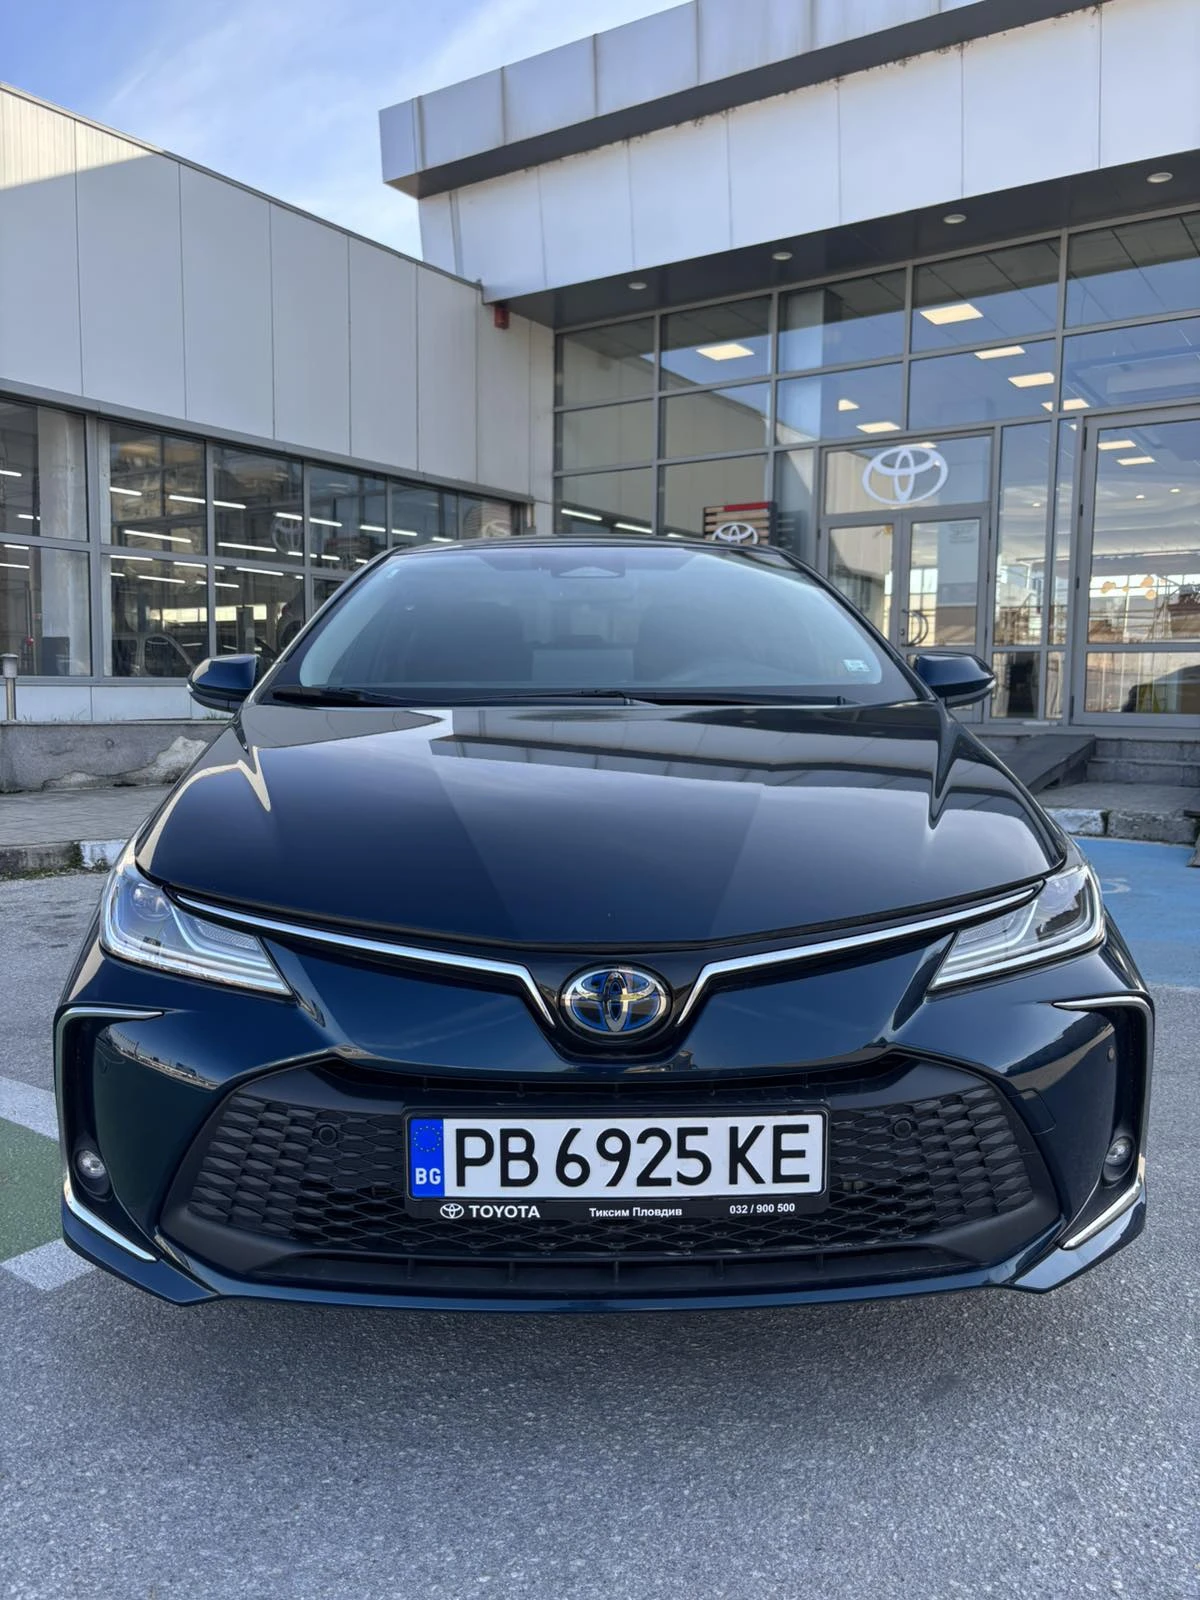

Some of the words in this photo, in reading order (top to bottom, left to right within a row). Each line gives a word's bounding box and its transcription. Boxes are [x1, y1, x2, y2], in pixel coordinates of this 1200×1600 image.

[455, 1128, 539, 1188] PB
[555, 1126, 712, 1188] 6925
[728, 1123, 810, 1186] KE
[415, 1167, 441, 1185] BG
[468, 1204, 541, 1219] TOYOTA
[588, 1207, 630, 1218] Тиксим
[632, 1206, 683, 1218] Пловдив
[729, 1204, 749, 1215] 032
[756, 1203, 775, 1214] 900
[776, 1202, 796, 1213] 500
